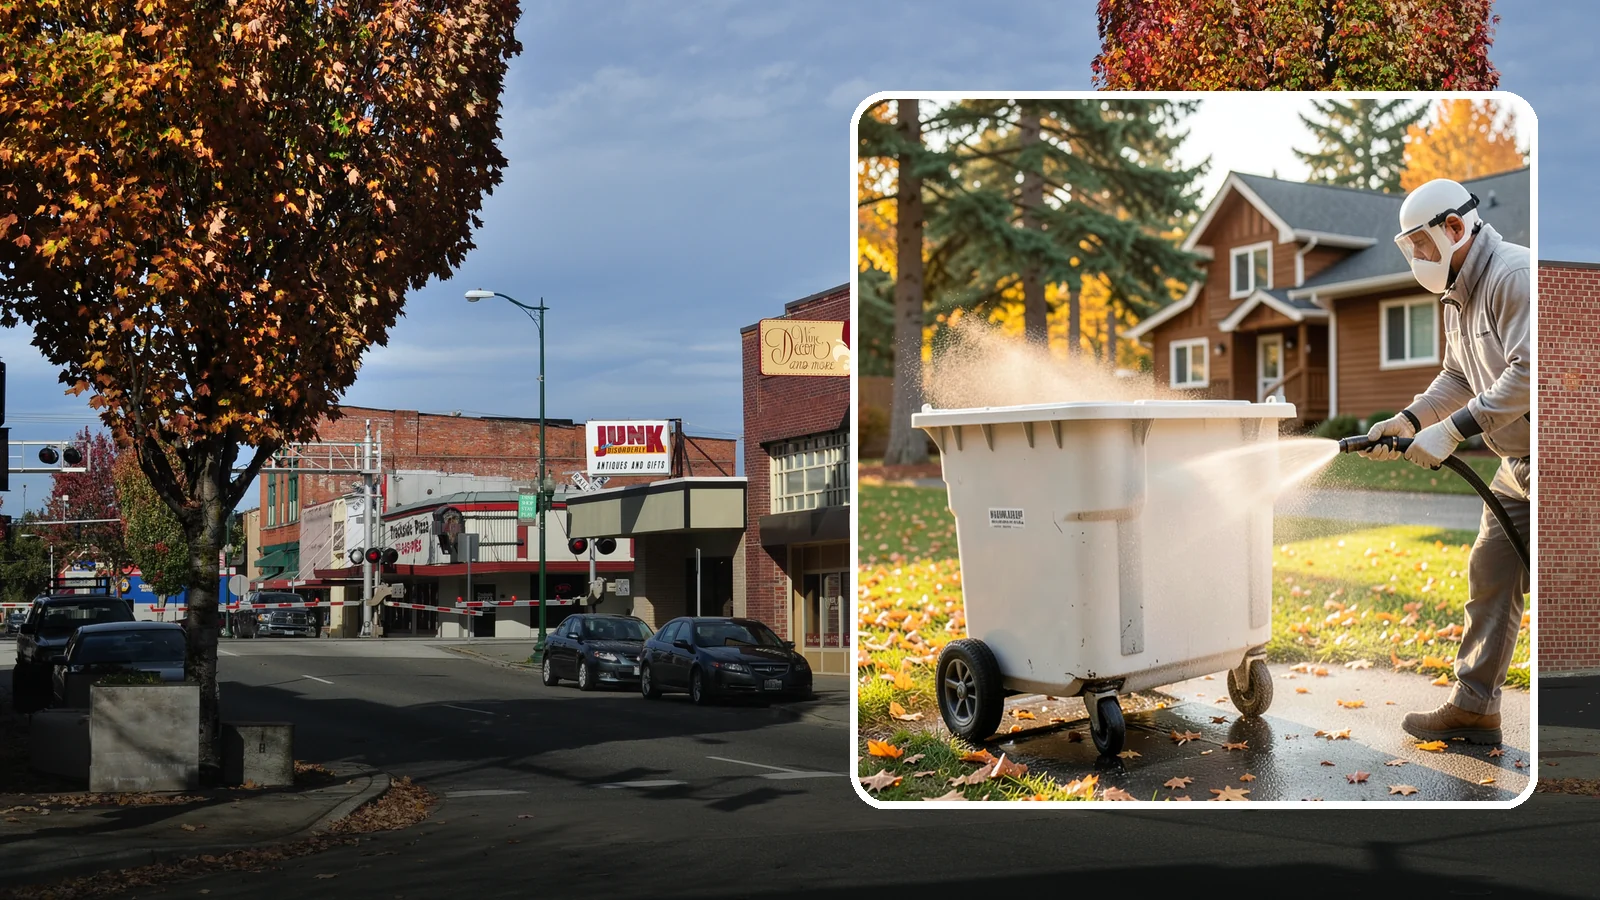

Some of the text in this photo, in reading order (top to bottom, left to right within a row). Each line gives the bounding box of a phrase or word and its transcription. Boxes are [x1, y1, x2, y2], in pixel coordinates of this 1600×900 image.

[595, 425, 664, 457] JUNK
[607, 446, 646, 454] DISORDERLY
[597, 461, 666, 470] ANTIQUES AND GIFTS
[573, 473, 589, 493] RAIL
[390, 519, 429, 540] Trackside Pizza
